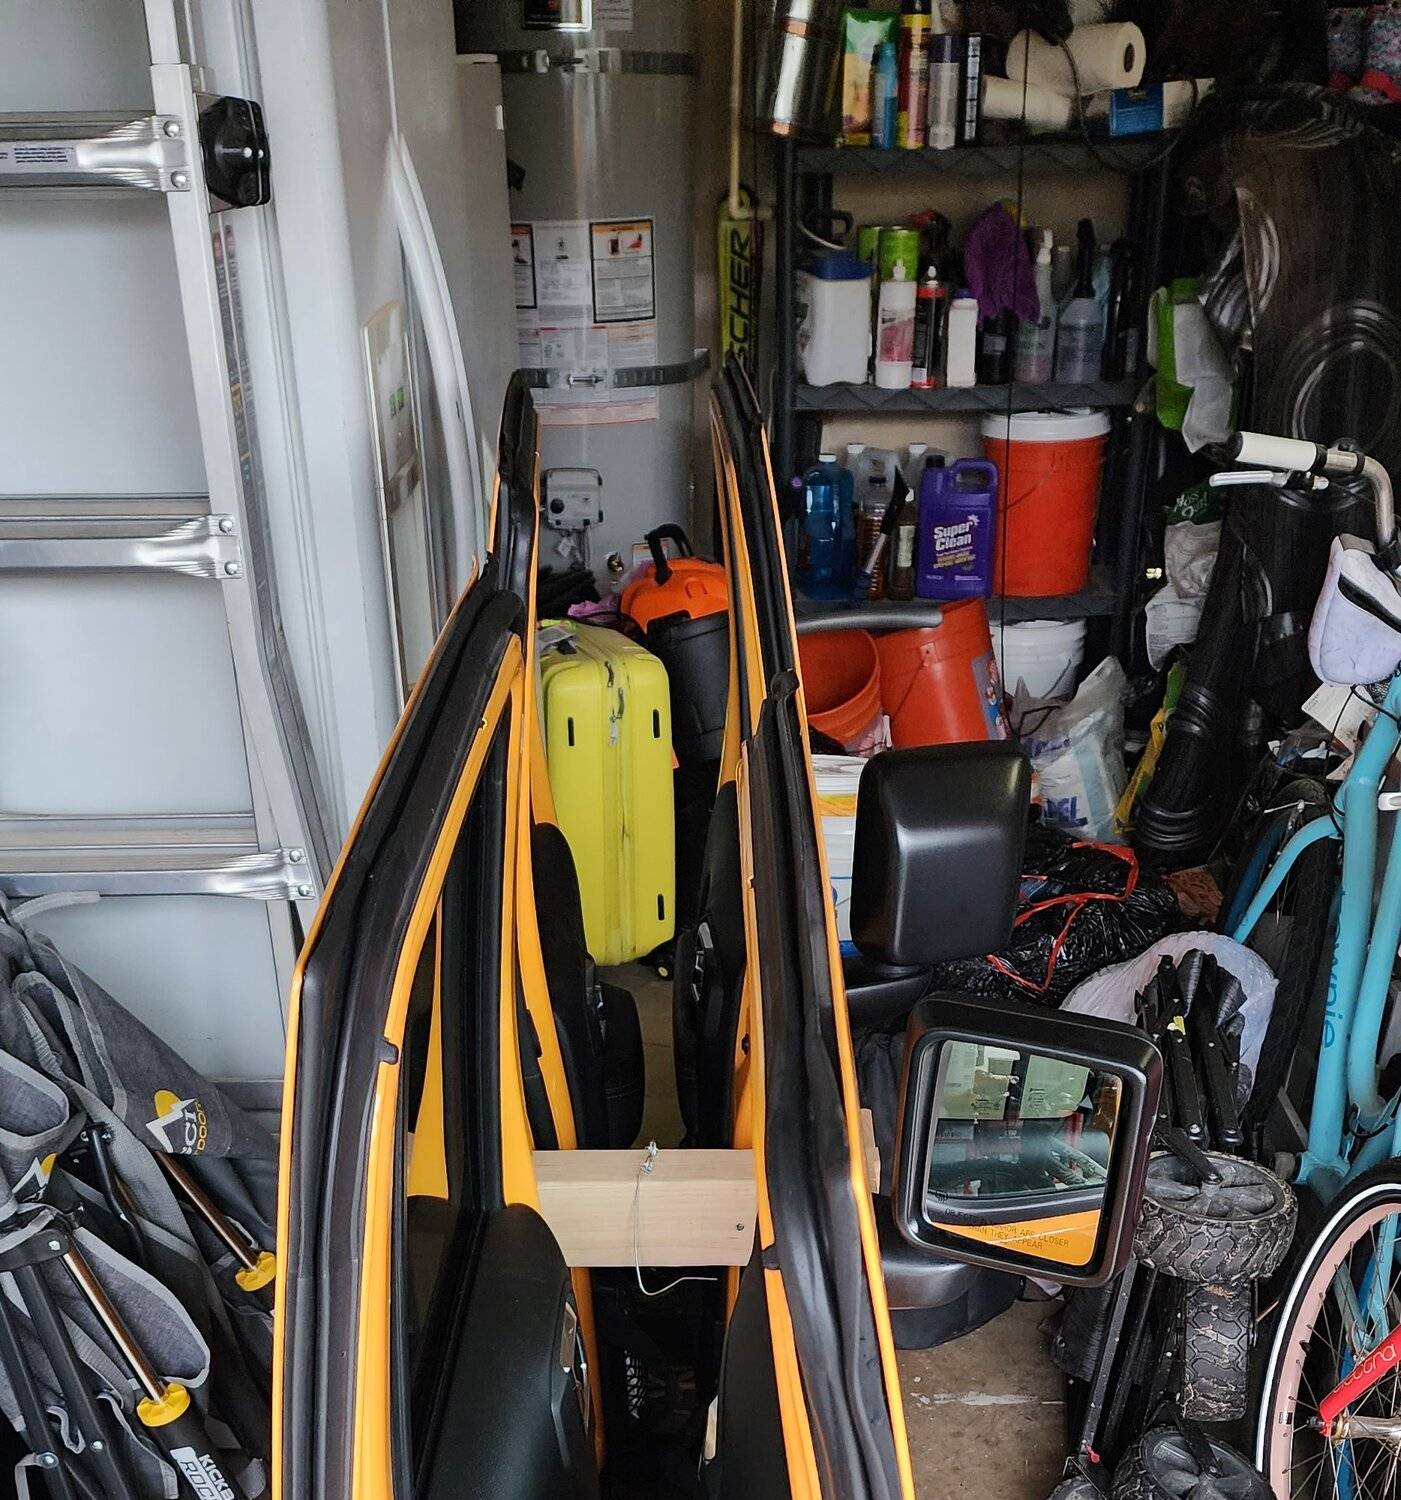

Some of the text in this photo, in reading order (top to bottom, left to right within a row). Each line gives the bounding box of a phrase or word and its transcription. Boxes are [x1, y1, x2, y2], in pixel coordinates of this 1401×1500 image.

[934, 521, 974, 540] Super
[935, 534, 972, 551] Clean
[991, 1229, 1009, 1240] THEY
[1038, 1233, 1070, 1248] CLOSER
